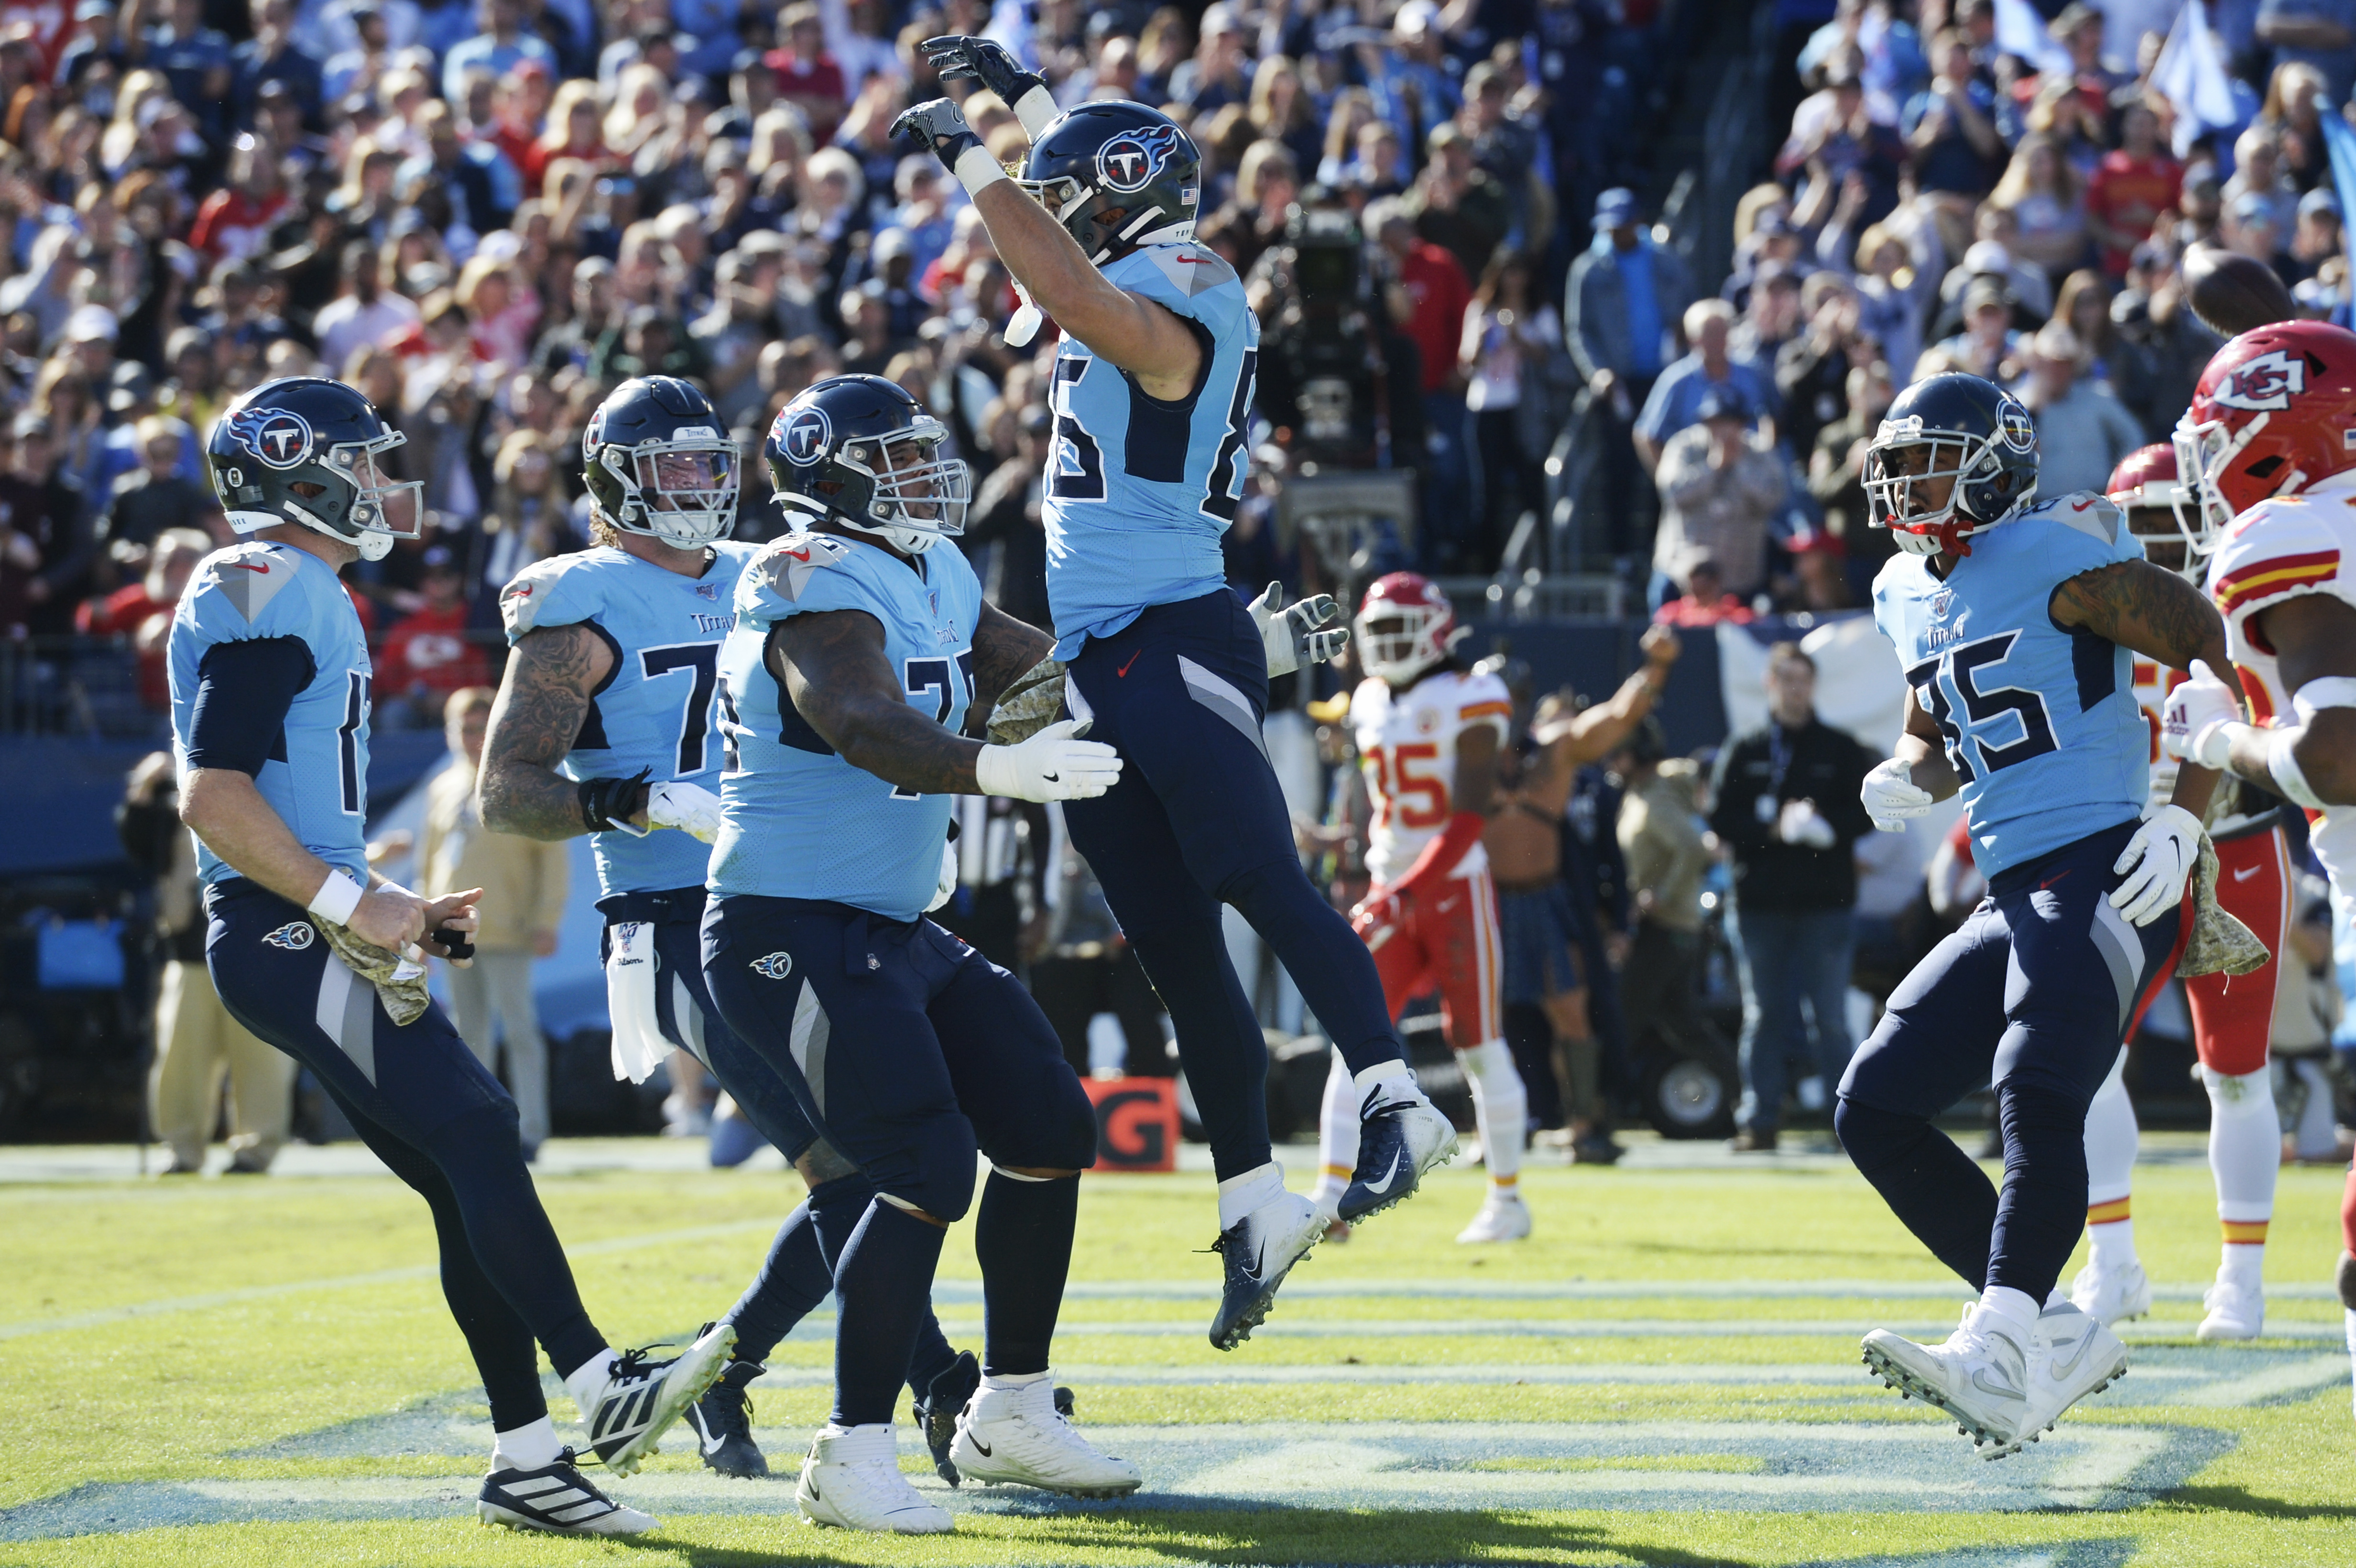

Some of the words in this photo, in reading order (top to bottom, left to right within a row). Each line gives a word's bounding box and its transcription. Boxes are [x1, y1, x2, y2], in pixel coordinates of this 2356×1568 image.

[1176, 227, 1193, 238] TEN
[2230, 364, 2289, 401] KC
[229, 518, 247, 526] SEE
[690, 613, 735, 634] TITAN
[336, 668, 373, 819] 1
[1096, 1091, 1163, 1165] G
